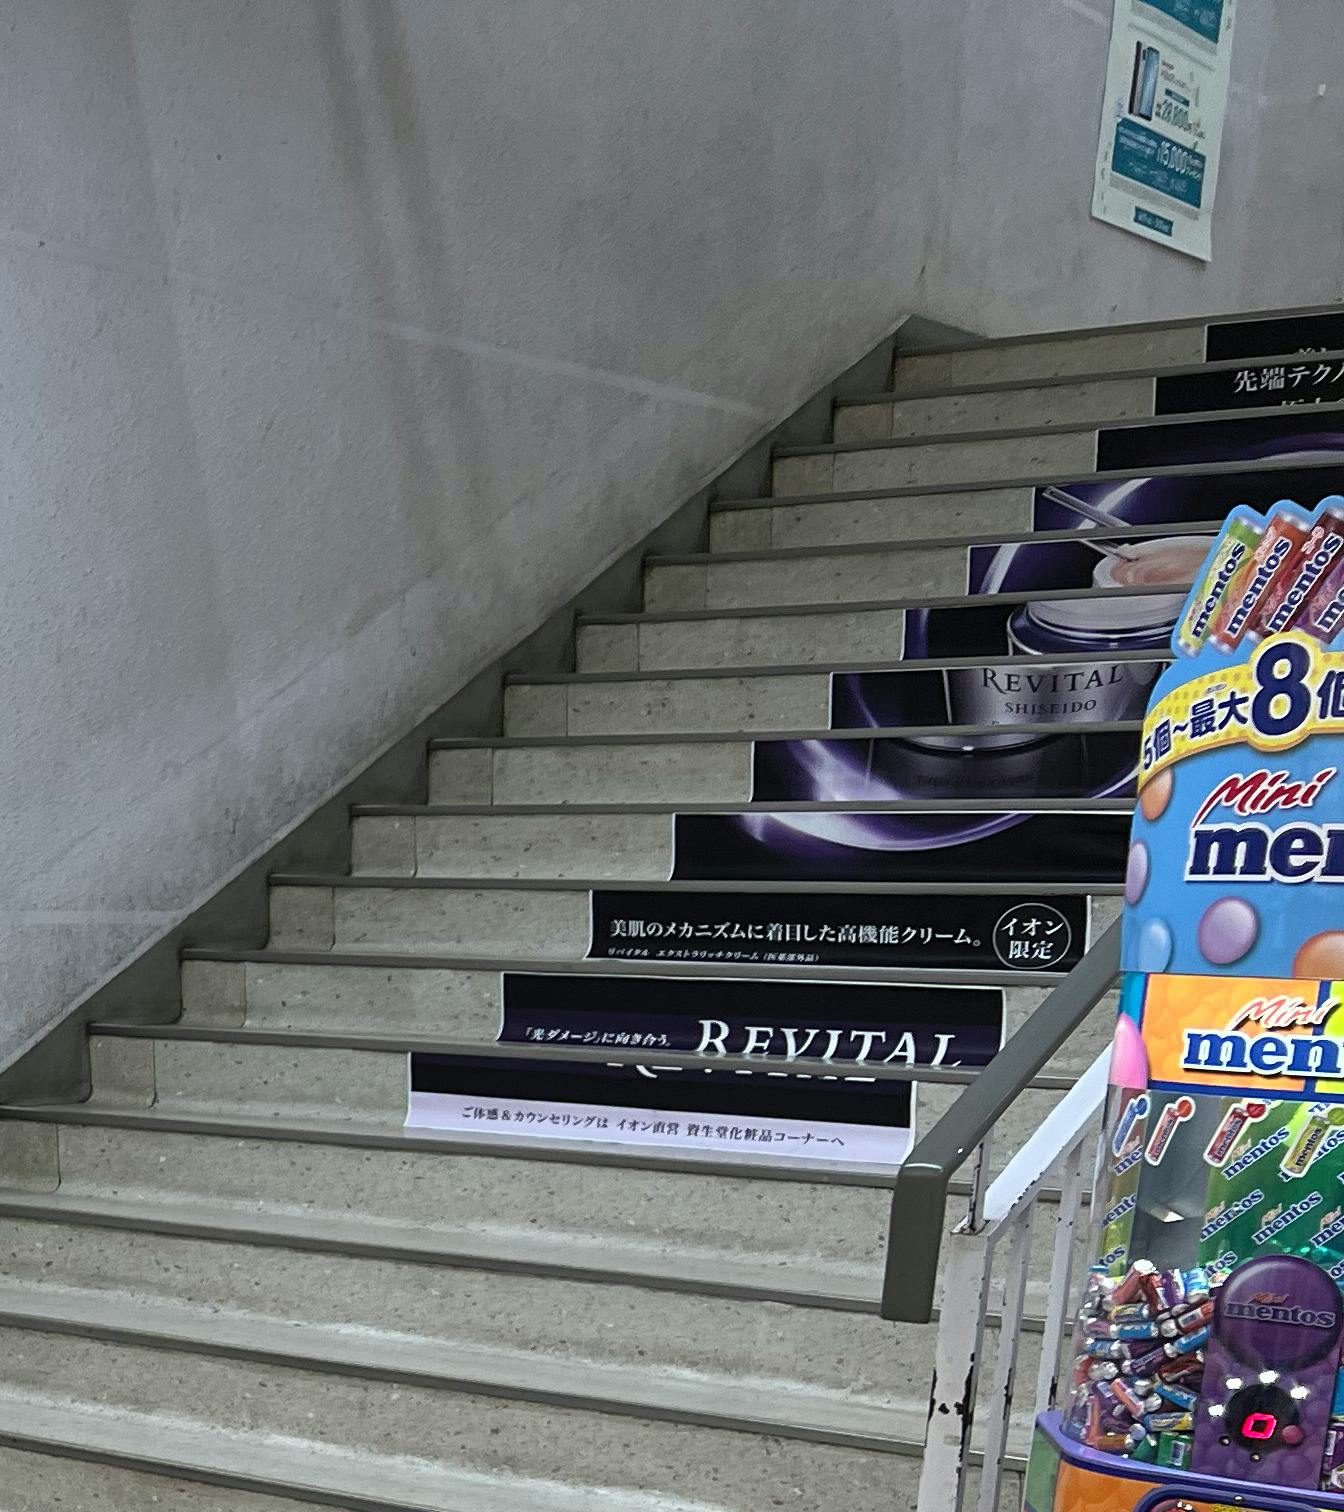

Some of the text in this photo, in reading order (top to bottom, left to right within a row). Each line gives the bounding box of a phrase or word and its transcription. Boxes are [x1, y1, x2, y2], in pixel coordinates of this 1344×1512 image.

[1225, 535, 1293, 639] mentos
[1265, 531, 1344, 635] mentos
[981, 663, 1125, 695] REVITAL
[1004, 699, 1098, 717] SHISEIDO
[1191, 766, 1337, 830] Mini
[611, 919, 981, 948] 美肌のメカニズムに着目した高機能クリーム。
[1000, 917, 1065, 937] イオン
[1008, 940, 1055, 960] 限定
[1226, 994, 1341, 1032] Mini
[695, 1019, 963, 1069] REVITAL
[615, 1117, 680, 1137] イオン直営
[686, 1120, 845, 1148] 資生堂化粧品コーナーへ
[1221, 1126, 1290, 1180] mentos
[1251, 1190, 1324, 1246] mentos
[1224, 1300, 1336, 1329] mentos
